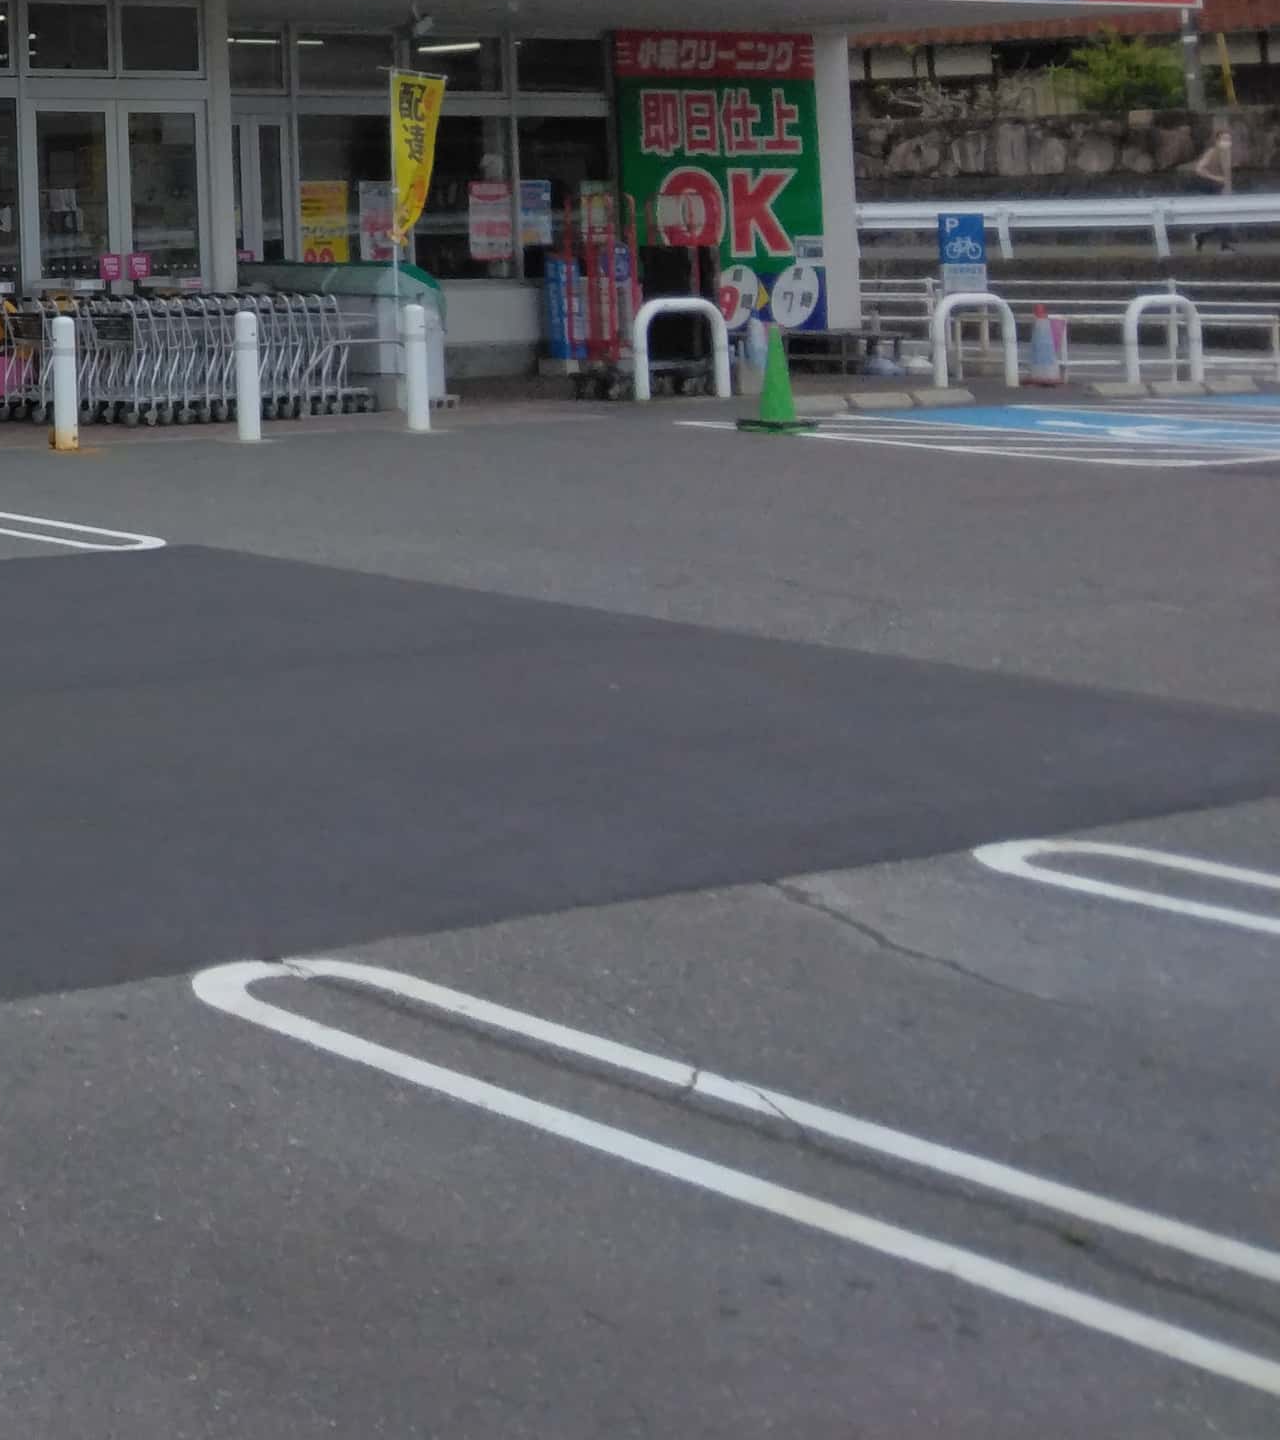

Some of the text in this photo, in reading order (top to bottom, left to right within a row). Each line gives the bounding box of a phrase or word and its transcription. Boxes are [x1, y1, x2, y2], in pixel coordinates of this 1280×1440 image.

[640, 87, 802, 158] 即日仕上
[656, 165, 798, 258] OK
[944, 217, 961, 234] P
